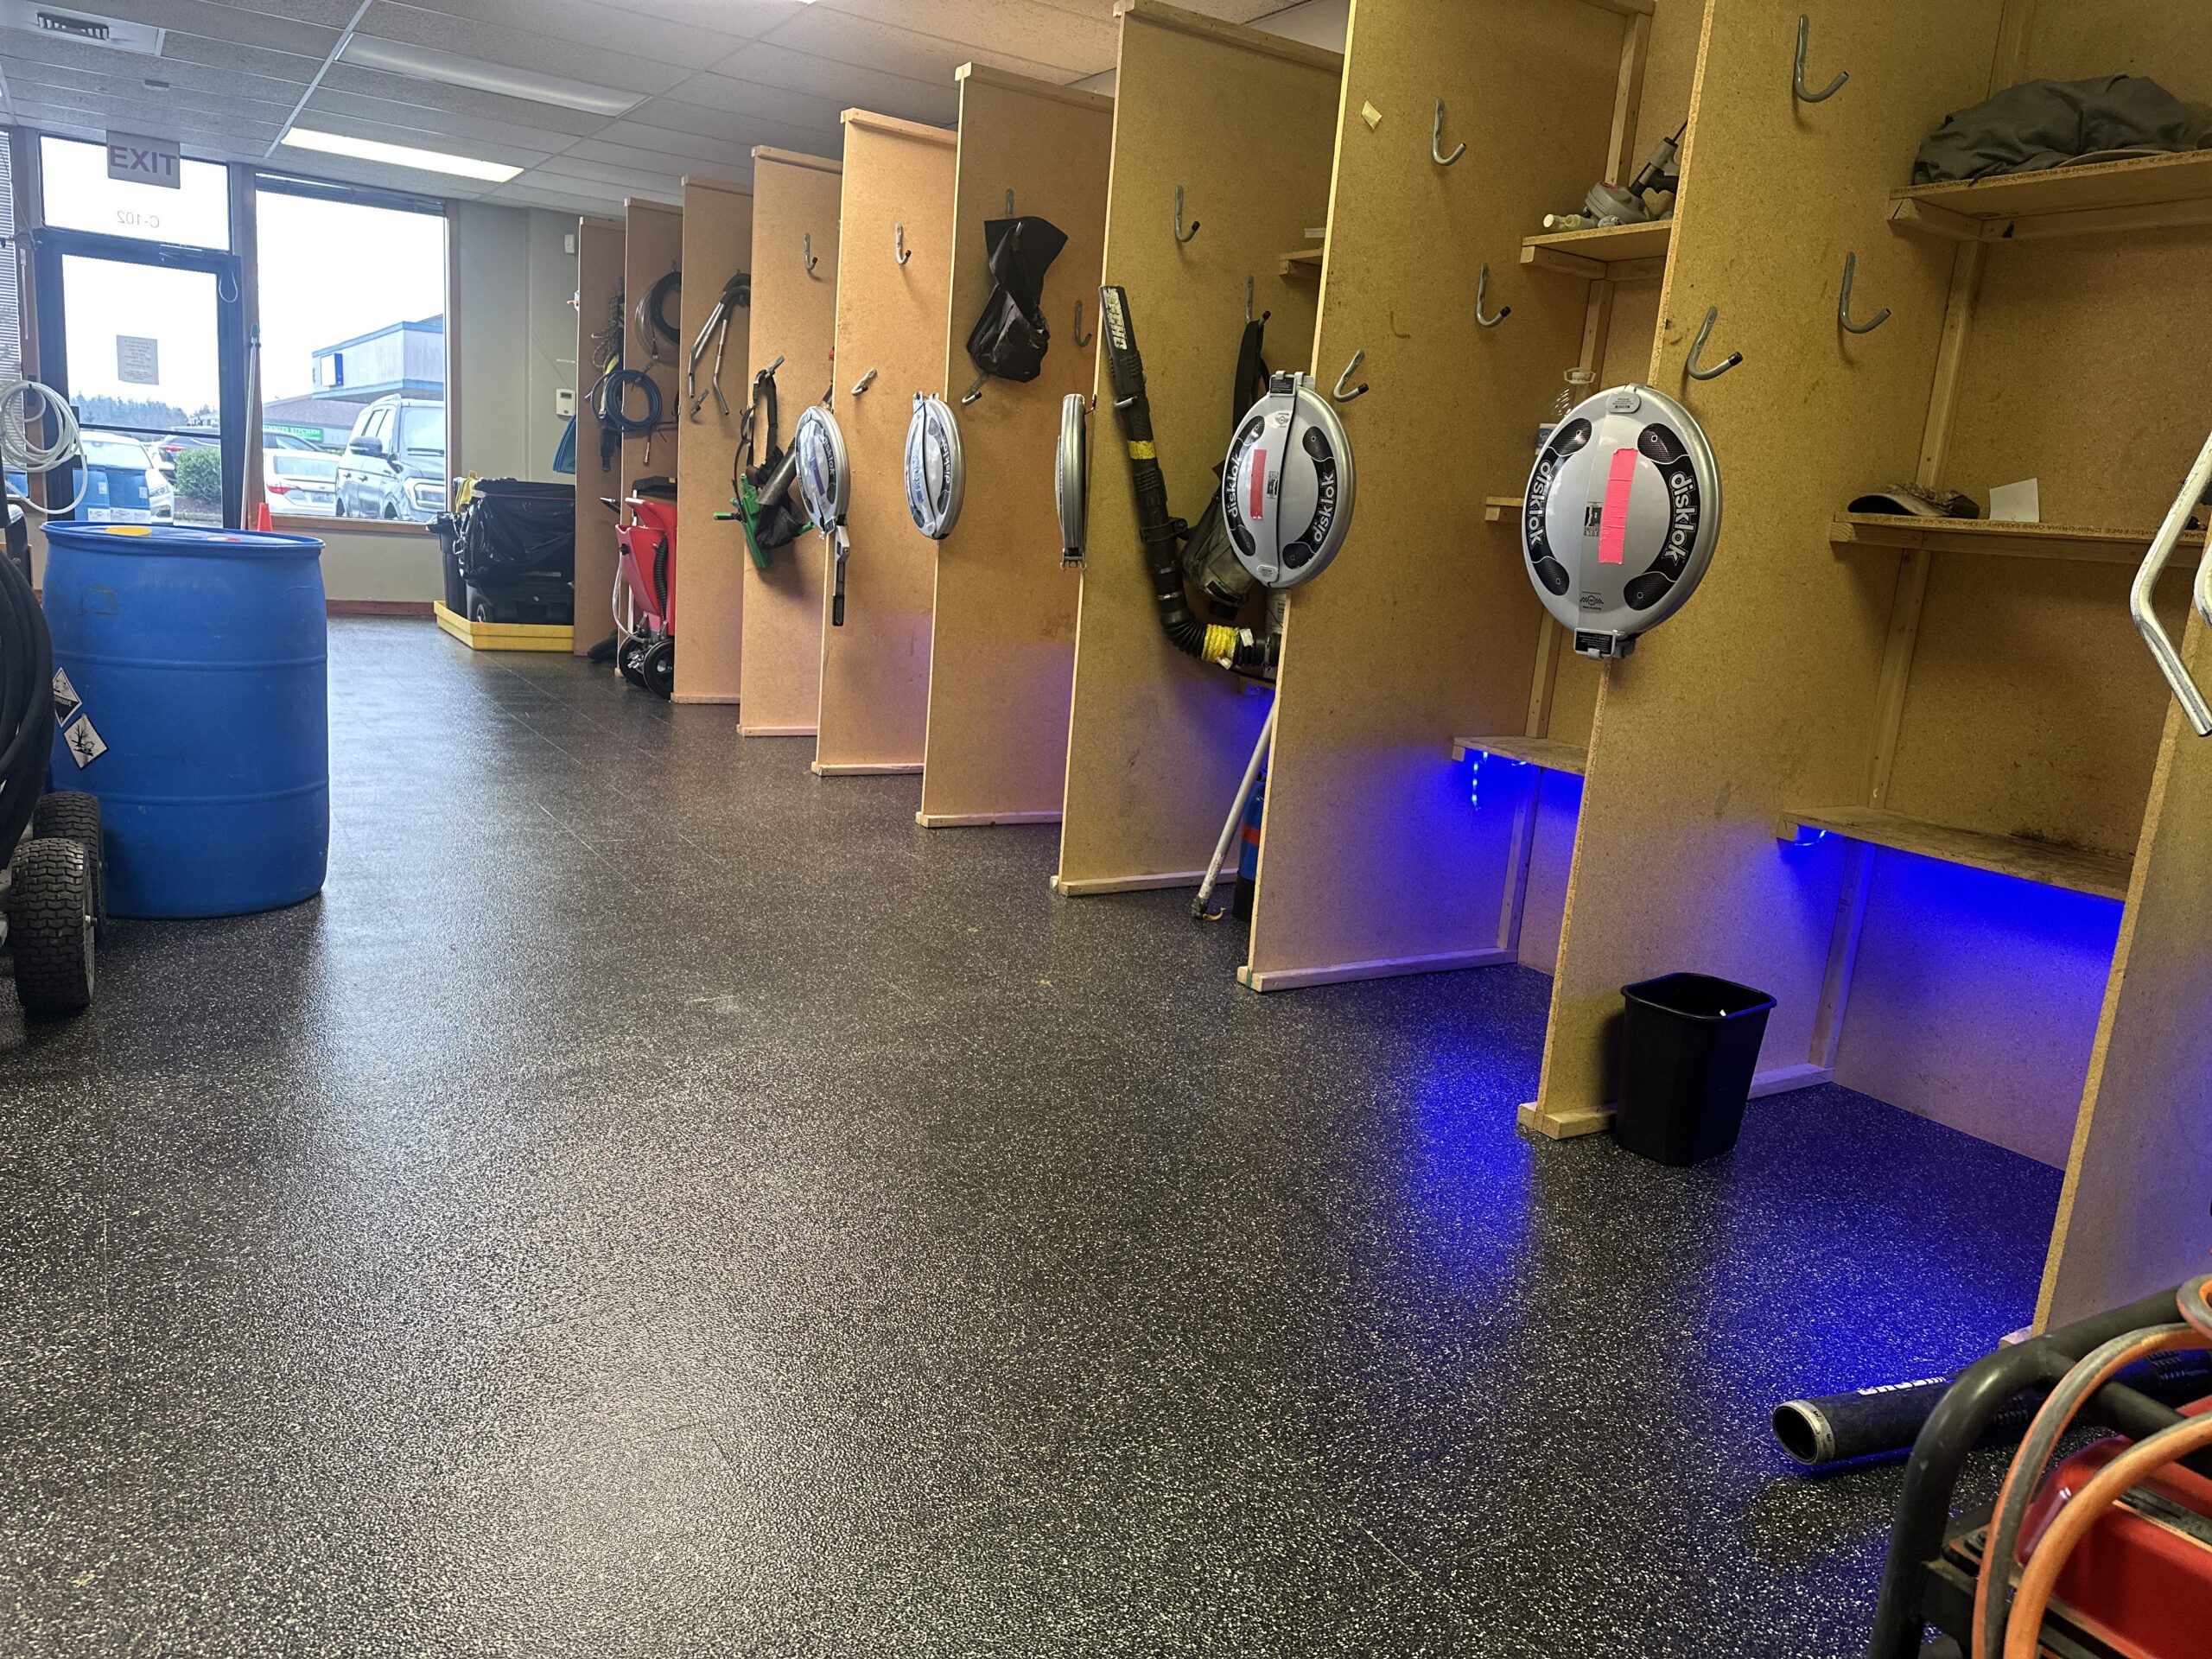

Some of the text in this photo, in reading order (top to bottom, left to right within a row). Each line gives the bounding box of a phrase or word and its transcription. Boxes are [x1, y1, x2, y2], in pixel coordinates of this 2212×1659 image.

[110, 145, 177, 175] EXIT
[1225, 454, 1242, 518] disklok
[1313, 471, 1335, 543] disklok
[1528, 459, 1554, 549] disklok
[1663, 472, 1694, 565] disklok
